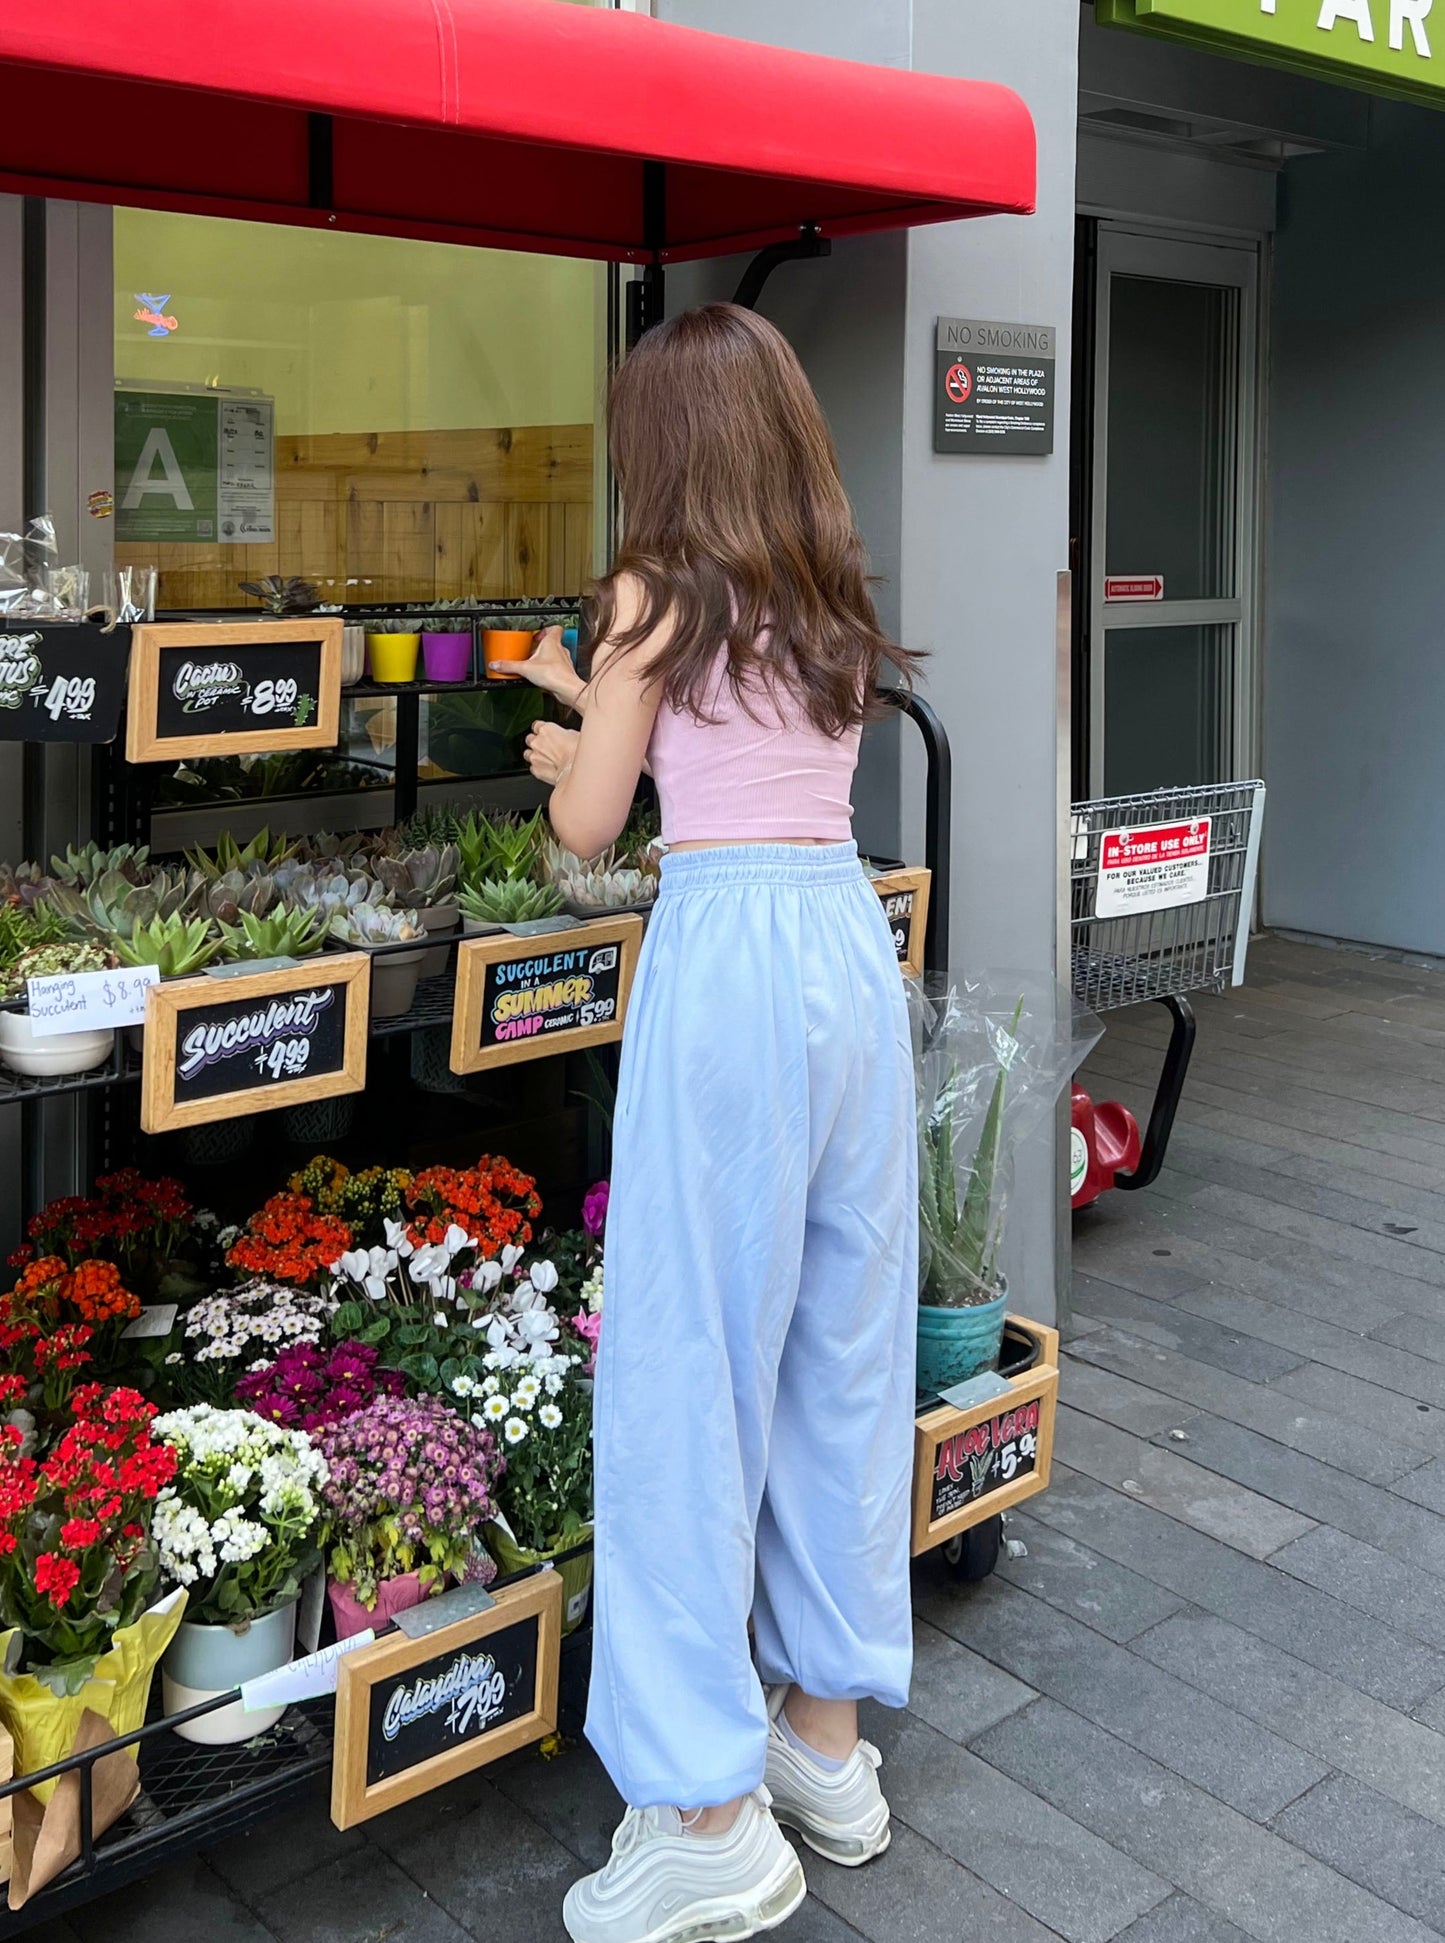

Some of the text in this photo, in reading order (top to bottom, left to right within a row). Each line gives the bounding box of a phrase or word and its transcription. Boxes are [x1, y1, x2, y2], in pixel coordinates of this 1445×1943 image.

[1261, 0, 1432, 58] AR
[948, 326, 1049, 350] NO SMOKING
[977, 366, 985, 374] NO
[987, 367, 1010, 375] SMOKING
[1014, 387, 1046, 395] HOLLYWOOD
[121, 427, 195, 510] A
[175, 661, 239, 694] Cactus
[1107, 842, 1157, 858] IN-STORE
[1160, 838, 1180, 851] USE
[1107, 872, 1120, 880] FOR
[1123, 870, 1136, 878] OUR
[1139, 867, 1162, 876] VALUED
[1127, 875, 1155, 885] BECAUSE
[1158, 873, 1167, 881] WE
[495, 950, 589, 985] SUCCULENT
[31, 980, 76, 1003] Hanging
[520, 977, 540, 989] IN A
[31, 995, 87, 1018] Succulent
[179, 988, 332, 1073] Succulent
[495, 1015, 544, 1040] CAMP
[544, 1013, 574, 1029] CERAMIC
[384, 1655, 493, 1733] Calandiva
